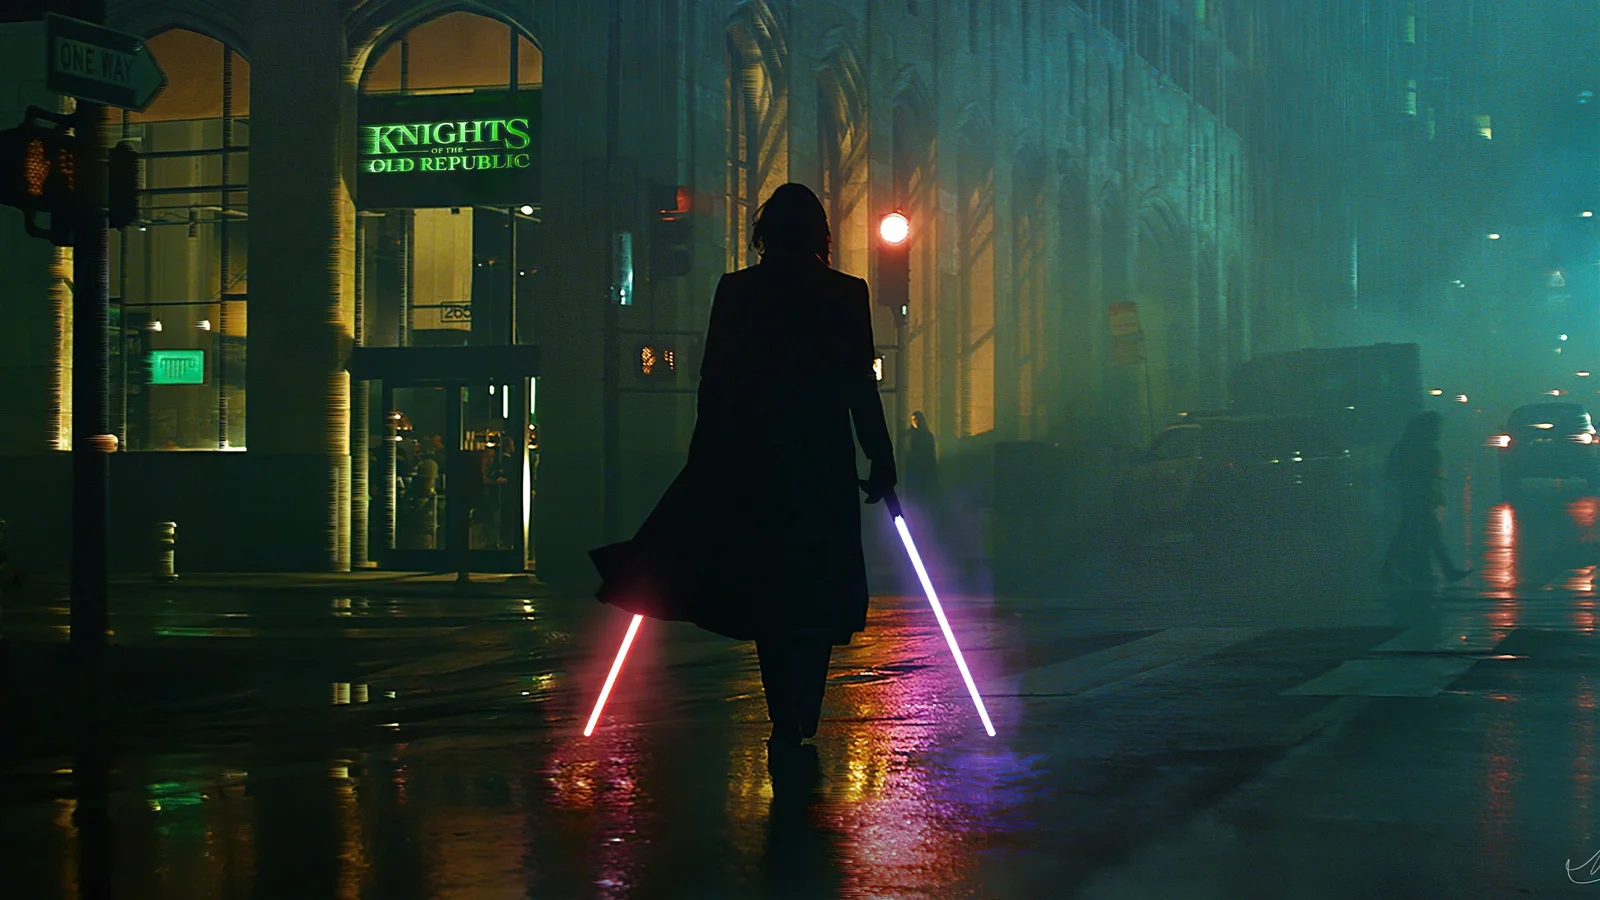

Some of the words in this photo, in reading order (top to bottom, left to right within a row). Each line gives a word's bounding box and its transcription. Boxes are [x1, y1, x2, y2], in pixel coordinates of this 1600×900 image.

[60, 43, 95, 75] ONE
[101, 50, 133, 83] WAY
[368, 118, 531, 155] KNIGHTS
[446, 146, 464, 154] THE
[369, 157, 415, 173] OLD
[420, 153, 531, 172] REPUBLIC
